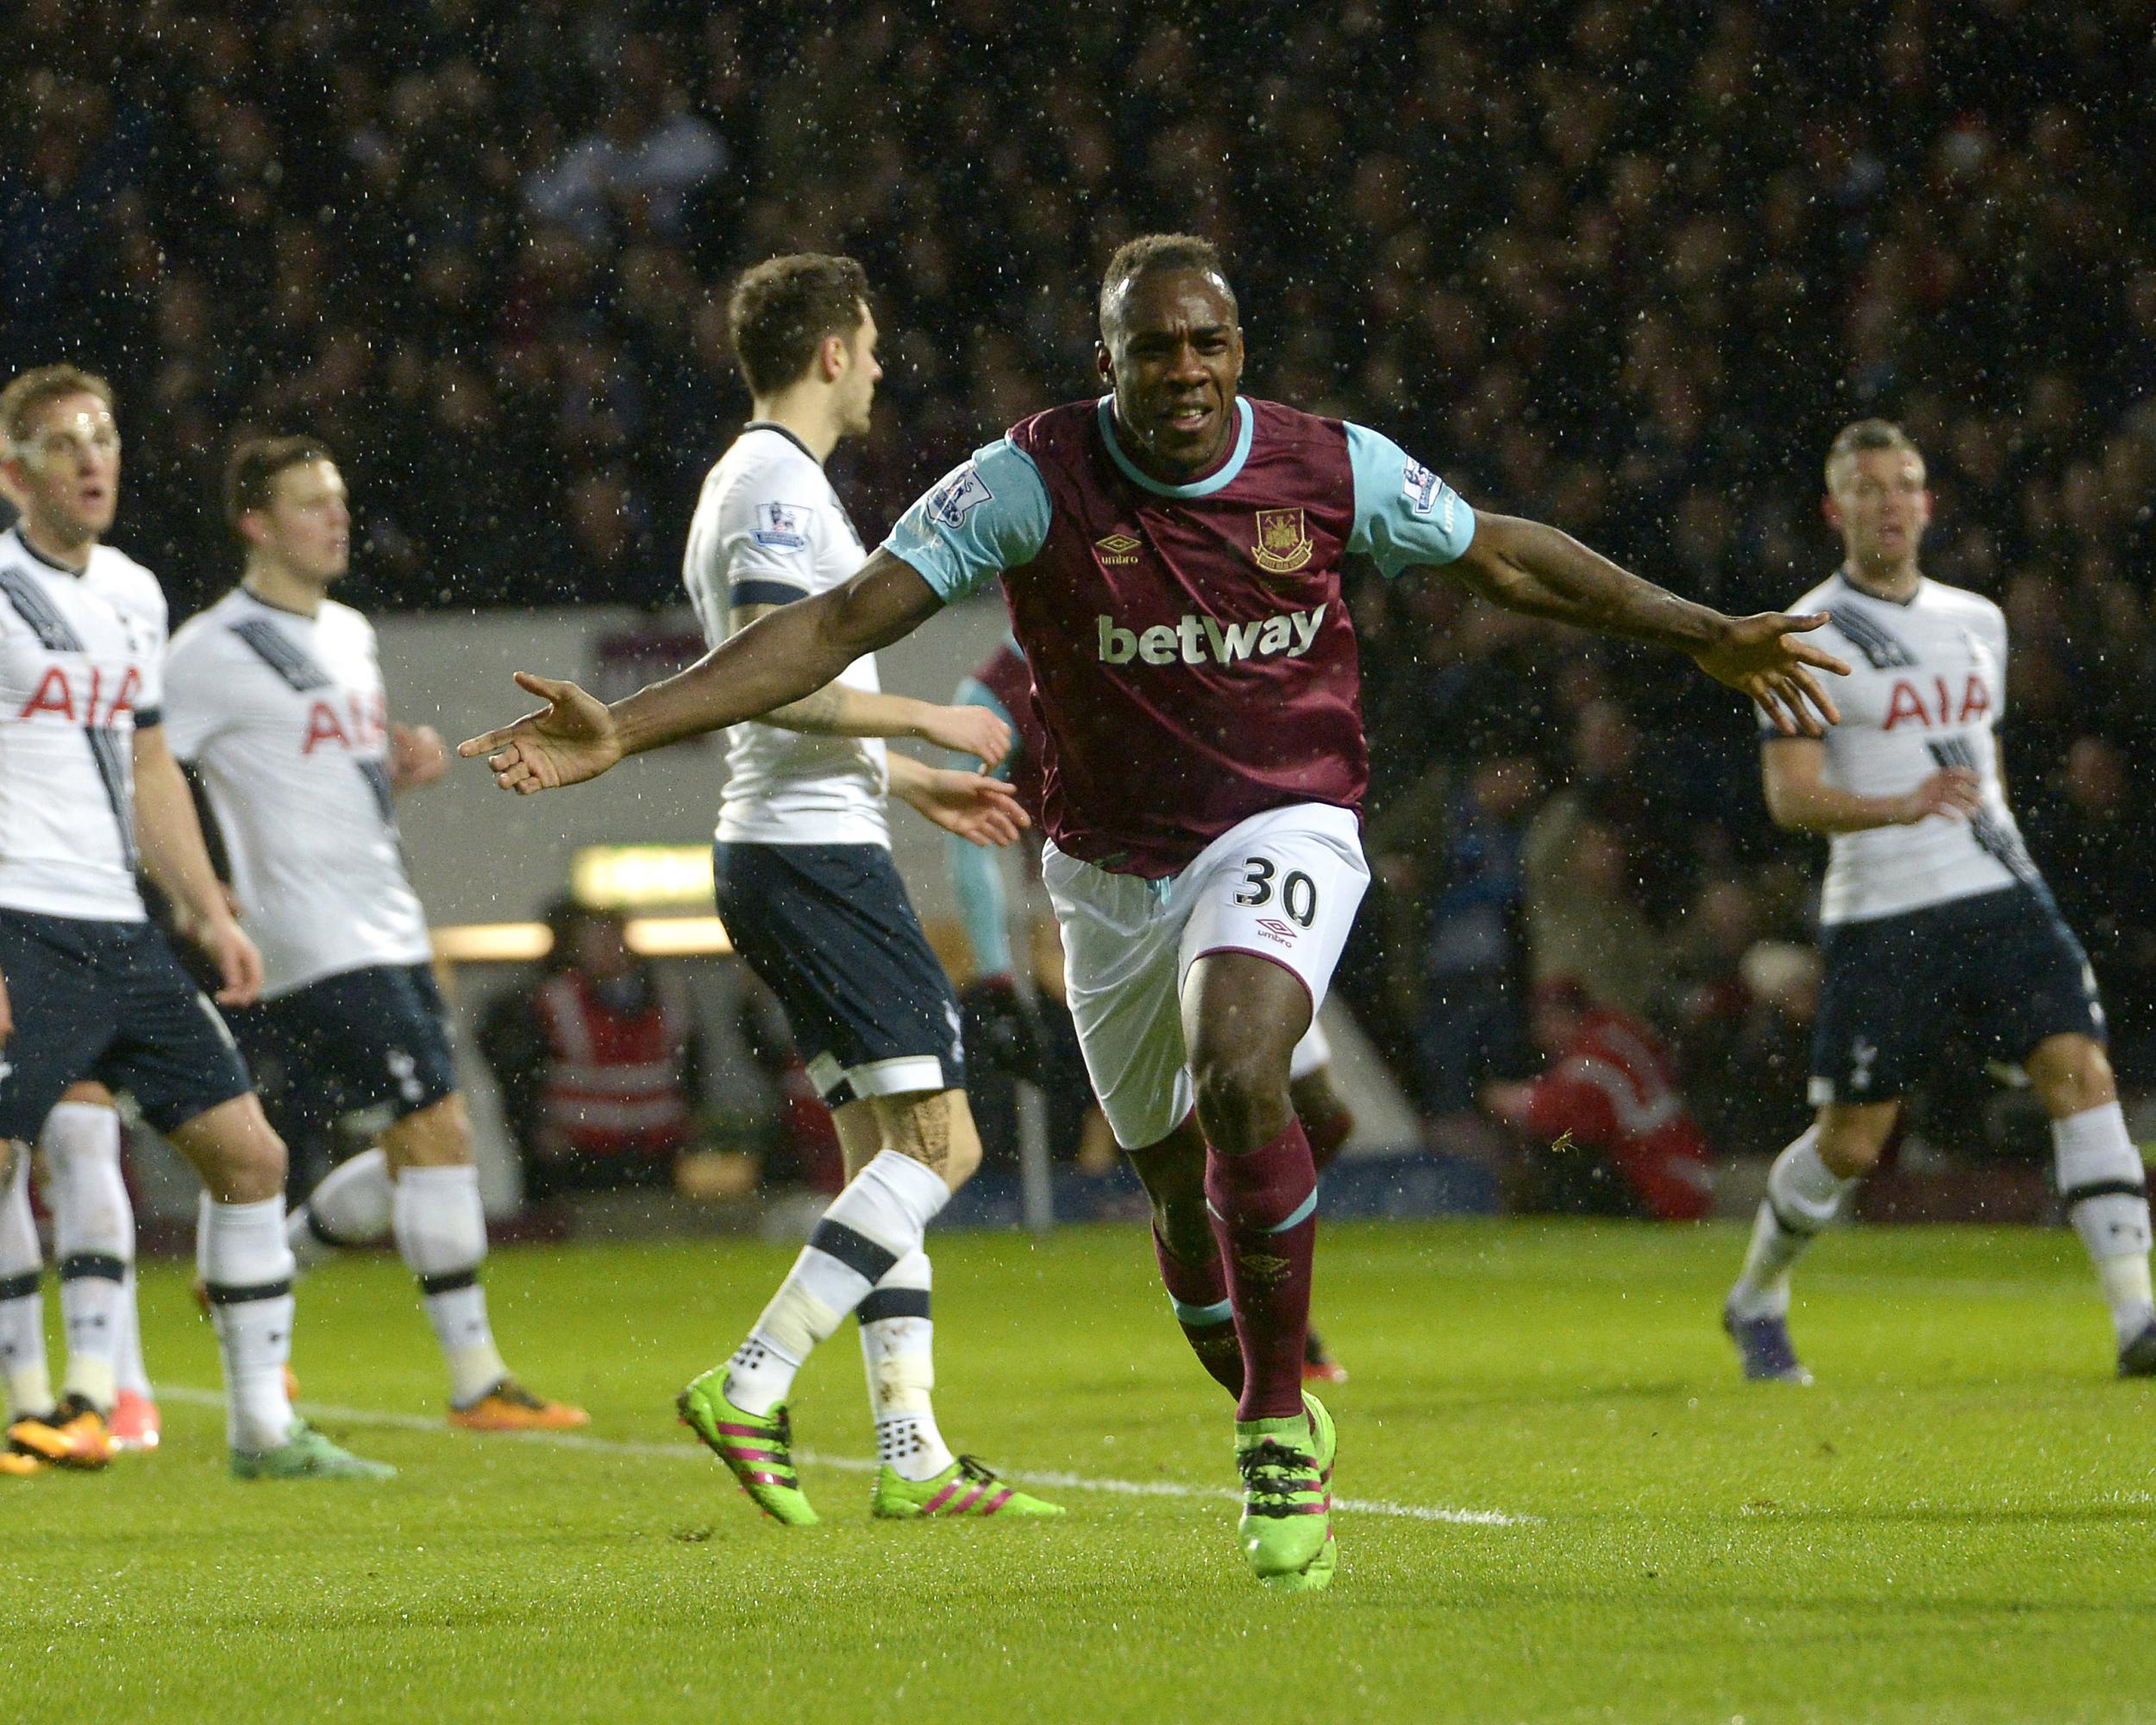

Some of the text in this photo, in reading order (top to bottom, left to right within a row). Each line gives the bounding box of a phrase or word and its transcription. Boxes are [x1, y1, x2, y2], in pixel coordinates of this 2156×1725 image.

[1101, 555, 1138, 565] umbro
[1099, 603, 1328, 667] betway
[18, 666, 141, 729] AIA
[1883, 673, 1990, 731] AIA
[1233, 856, 1317, 930] 30
[1257, 930, 1292, 948] umbro
